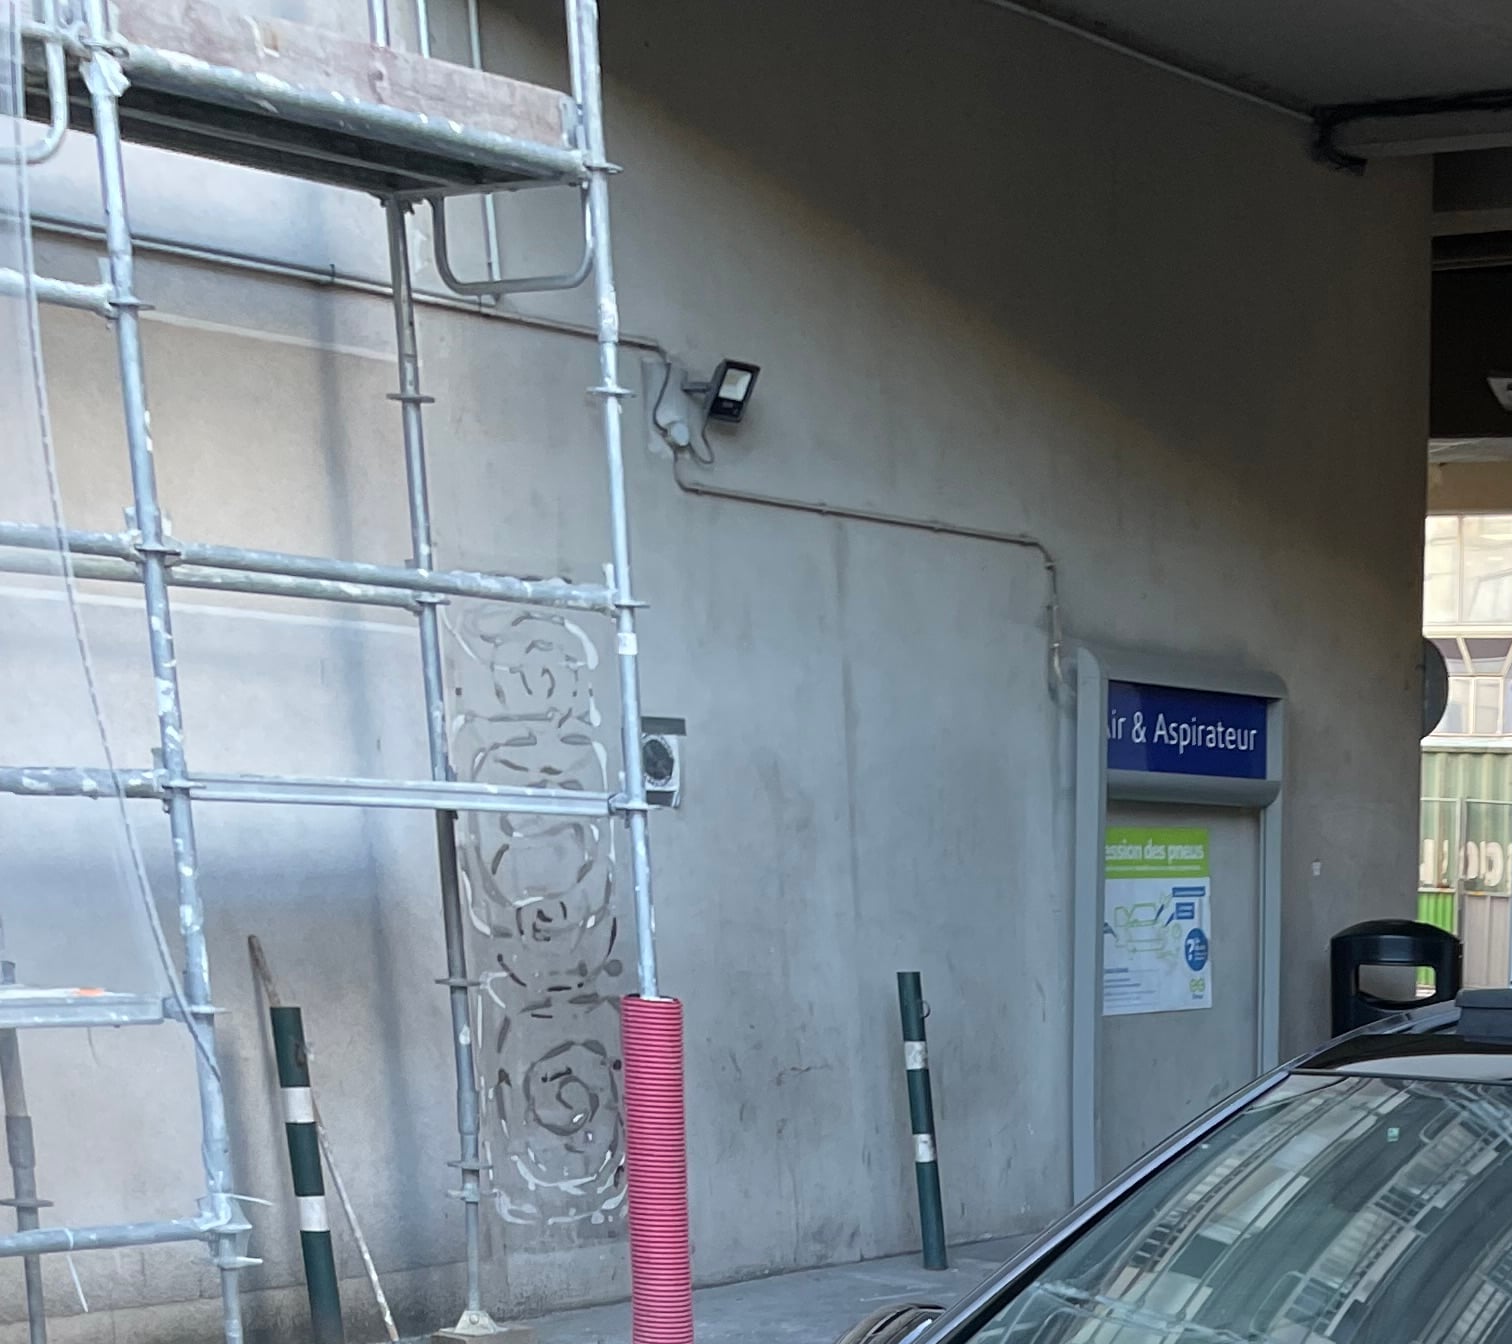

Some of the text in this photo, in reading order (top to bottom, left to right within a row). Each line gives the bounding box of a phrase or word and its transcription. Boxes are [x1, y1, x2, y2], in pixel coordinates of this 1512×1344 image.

[1131, 711, 1147, 744] &
[1153, 713, 1258, 755] Aspirateur
[1143, 838, 1166, 860] des
